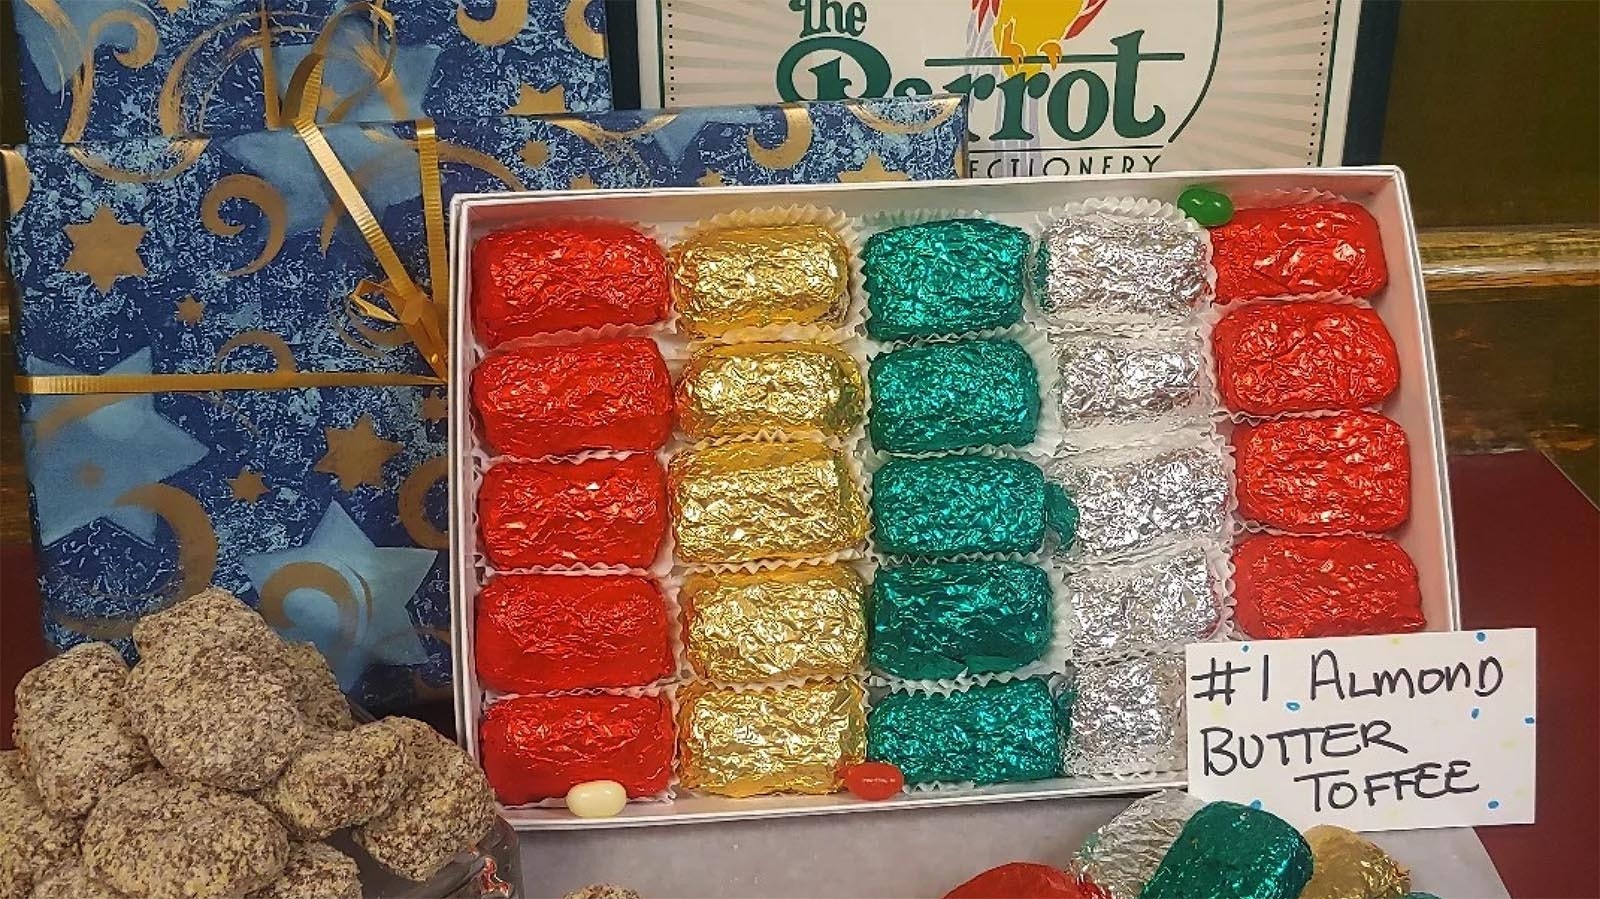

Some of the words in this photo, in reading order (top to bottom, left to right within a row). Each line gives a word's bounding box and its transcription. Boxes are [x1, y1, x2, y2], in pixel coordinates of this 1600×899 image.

[788, 0, 867, 38] The
[776, 30, 1166, 142] Prrot
[1190, 654, 1269, 704] #1
[1200, 720, 1408, 776] BUTTER
[1293, 760, 1480, 812] TOFFEE
